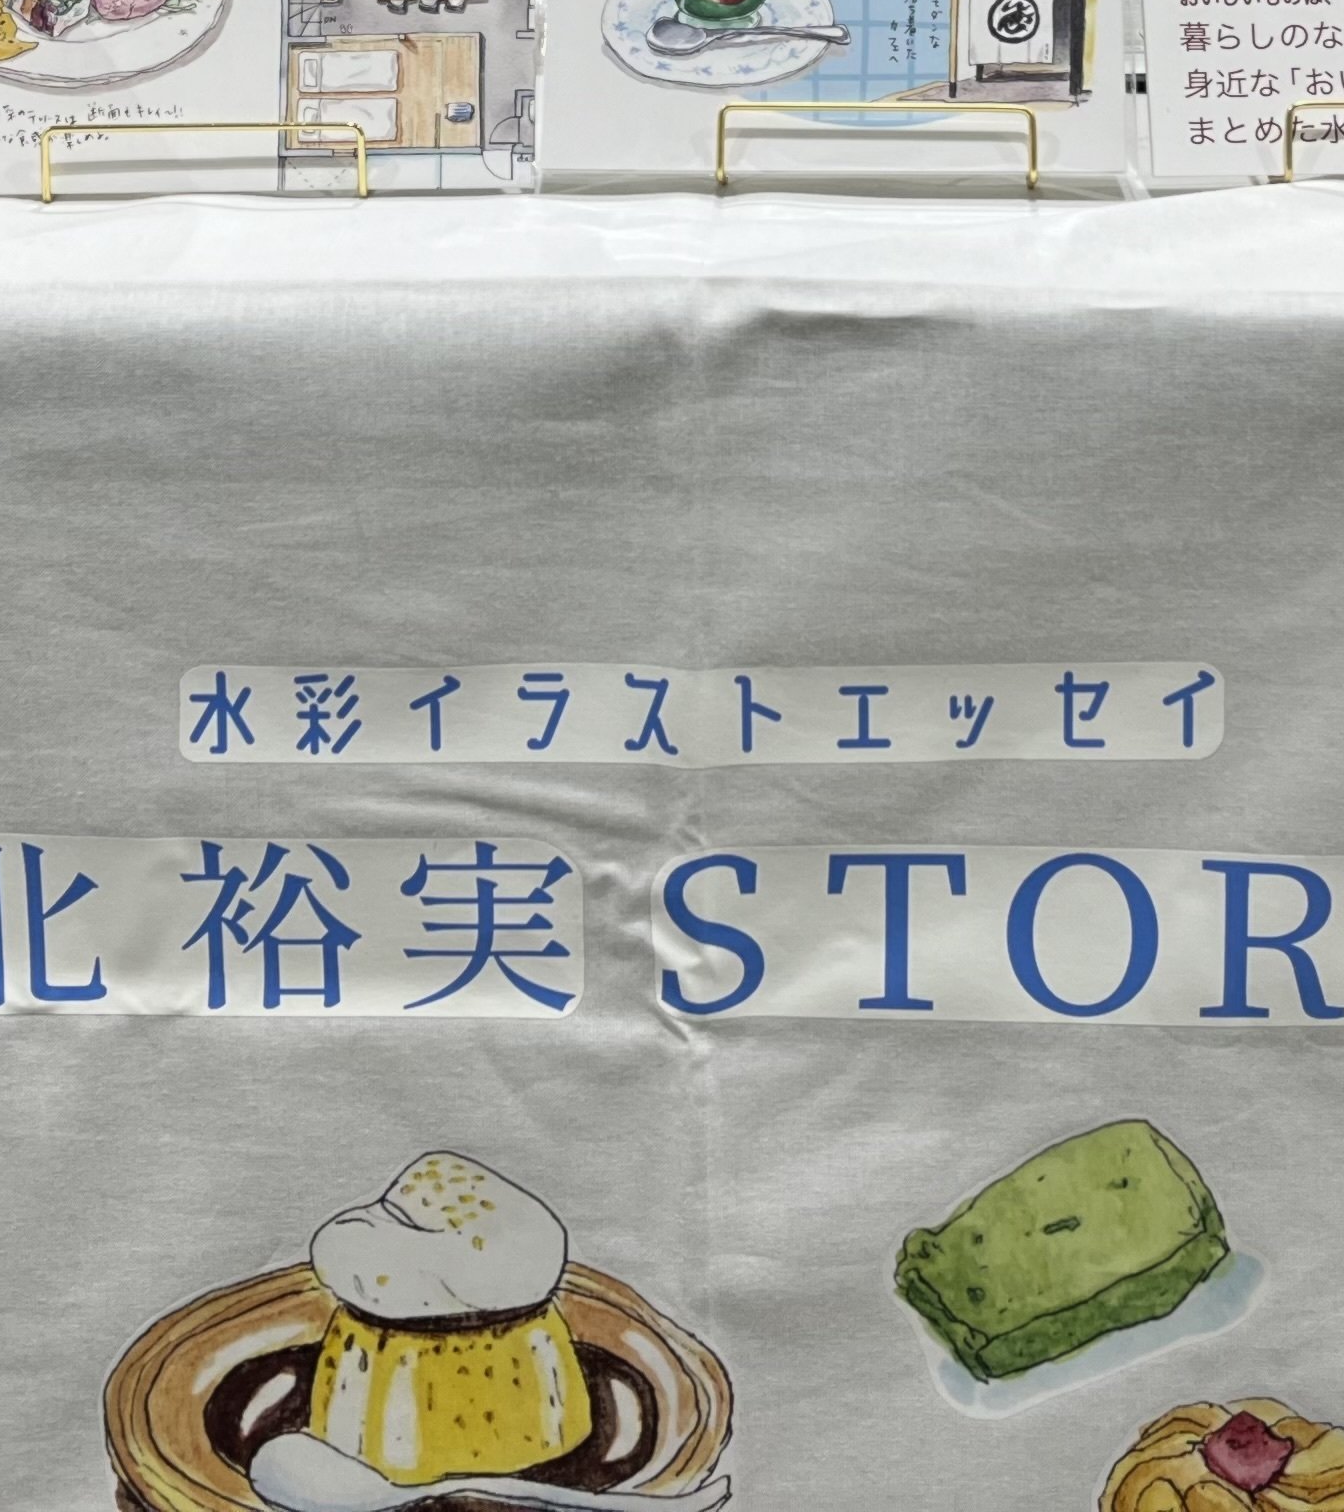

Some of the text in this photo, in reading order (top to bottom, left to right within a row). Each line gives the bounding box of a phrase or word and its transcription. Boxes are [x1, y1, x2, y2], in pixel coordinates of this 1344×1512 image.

[889, 20, 899, 63] カフェへ
[186, 668, 1218, 757] 水彩イラストエッセイ
